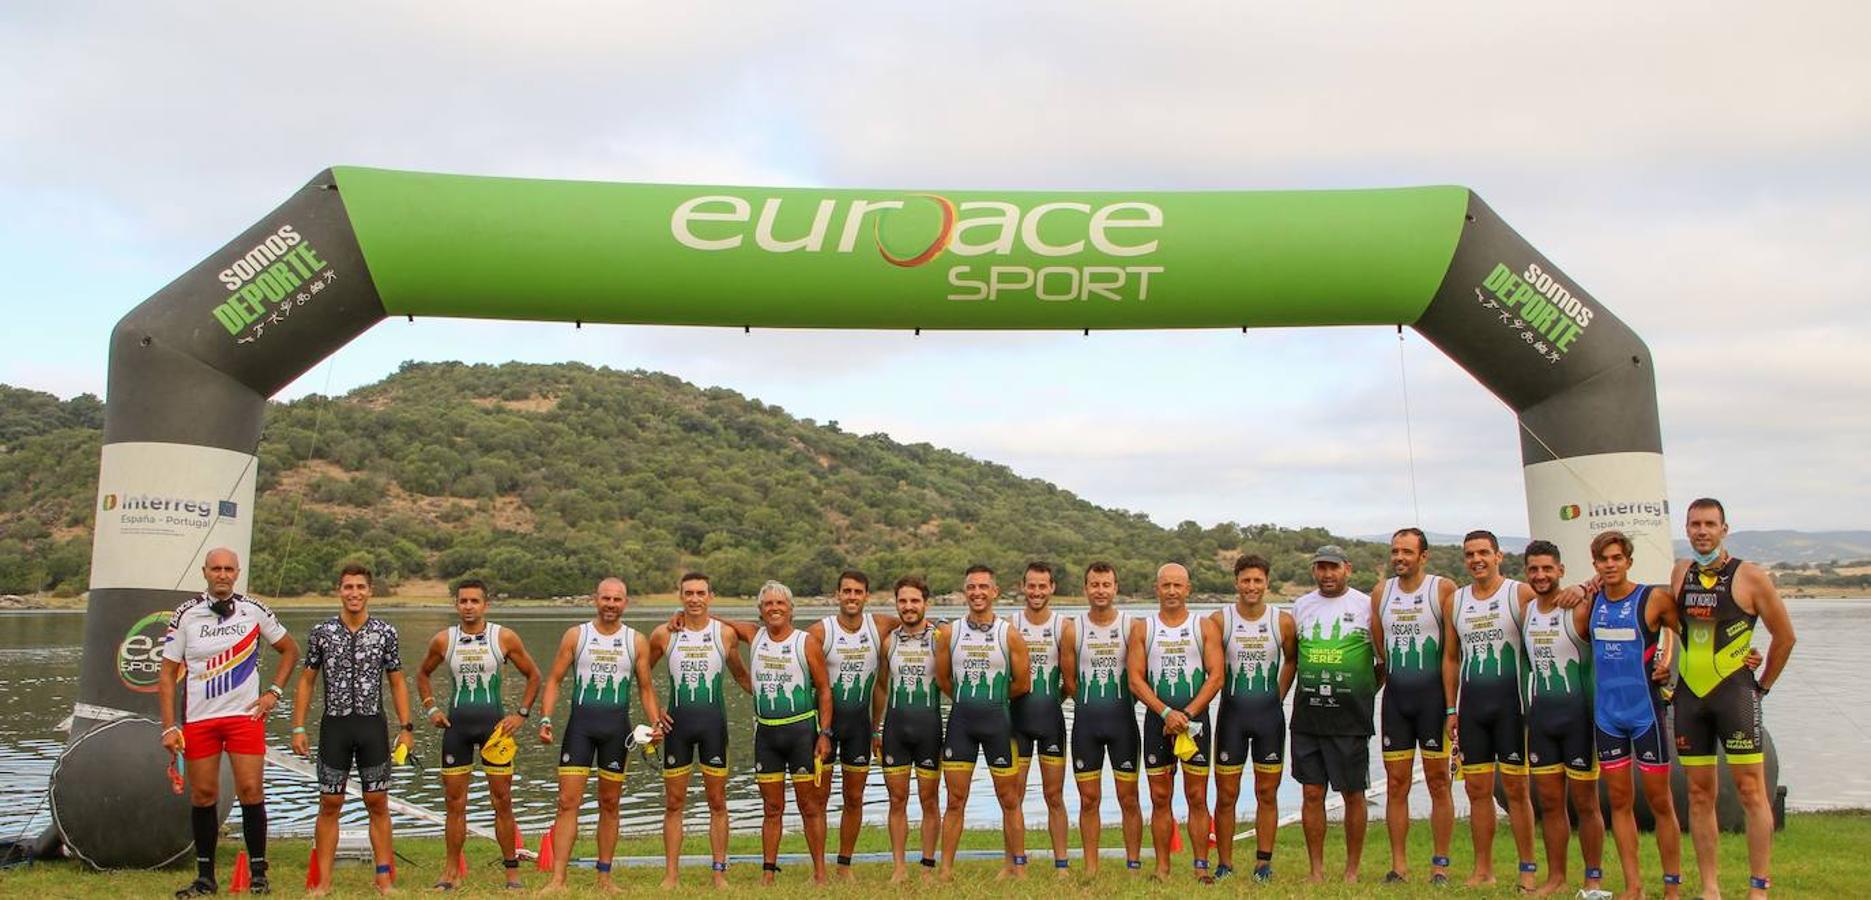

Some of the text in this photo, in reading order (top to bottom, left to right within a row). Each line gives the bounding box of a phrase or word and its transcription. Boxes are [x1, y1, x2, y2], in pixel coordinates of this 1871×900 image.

[671, 194, 1164, 267] euroace
[218, 225, 301, 291] SOMOS
[212, 240, 328, 336] DEPORTE
[947, 265, 1164, 301] SPORT
[1523, 263, 1595, 328] SOMOS
[1482, 262, 1584, 354] DEPORTE
[121, 494, 211, 517] Interreg
[120, 514, 156, 525] España
[166, 515, 211, 528] Portugal
[200, 624, 247, 638] Banesto
[1308, 654, 1343, 664] JEREZ
[1605, 642, 1621, 651] IMC
[680, 660, 708, 672] REALES
